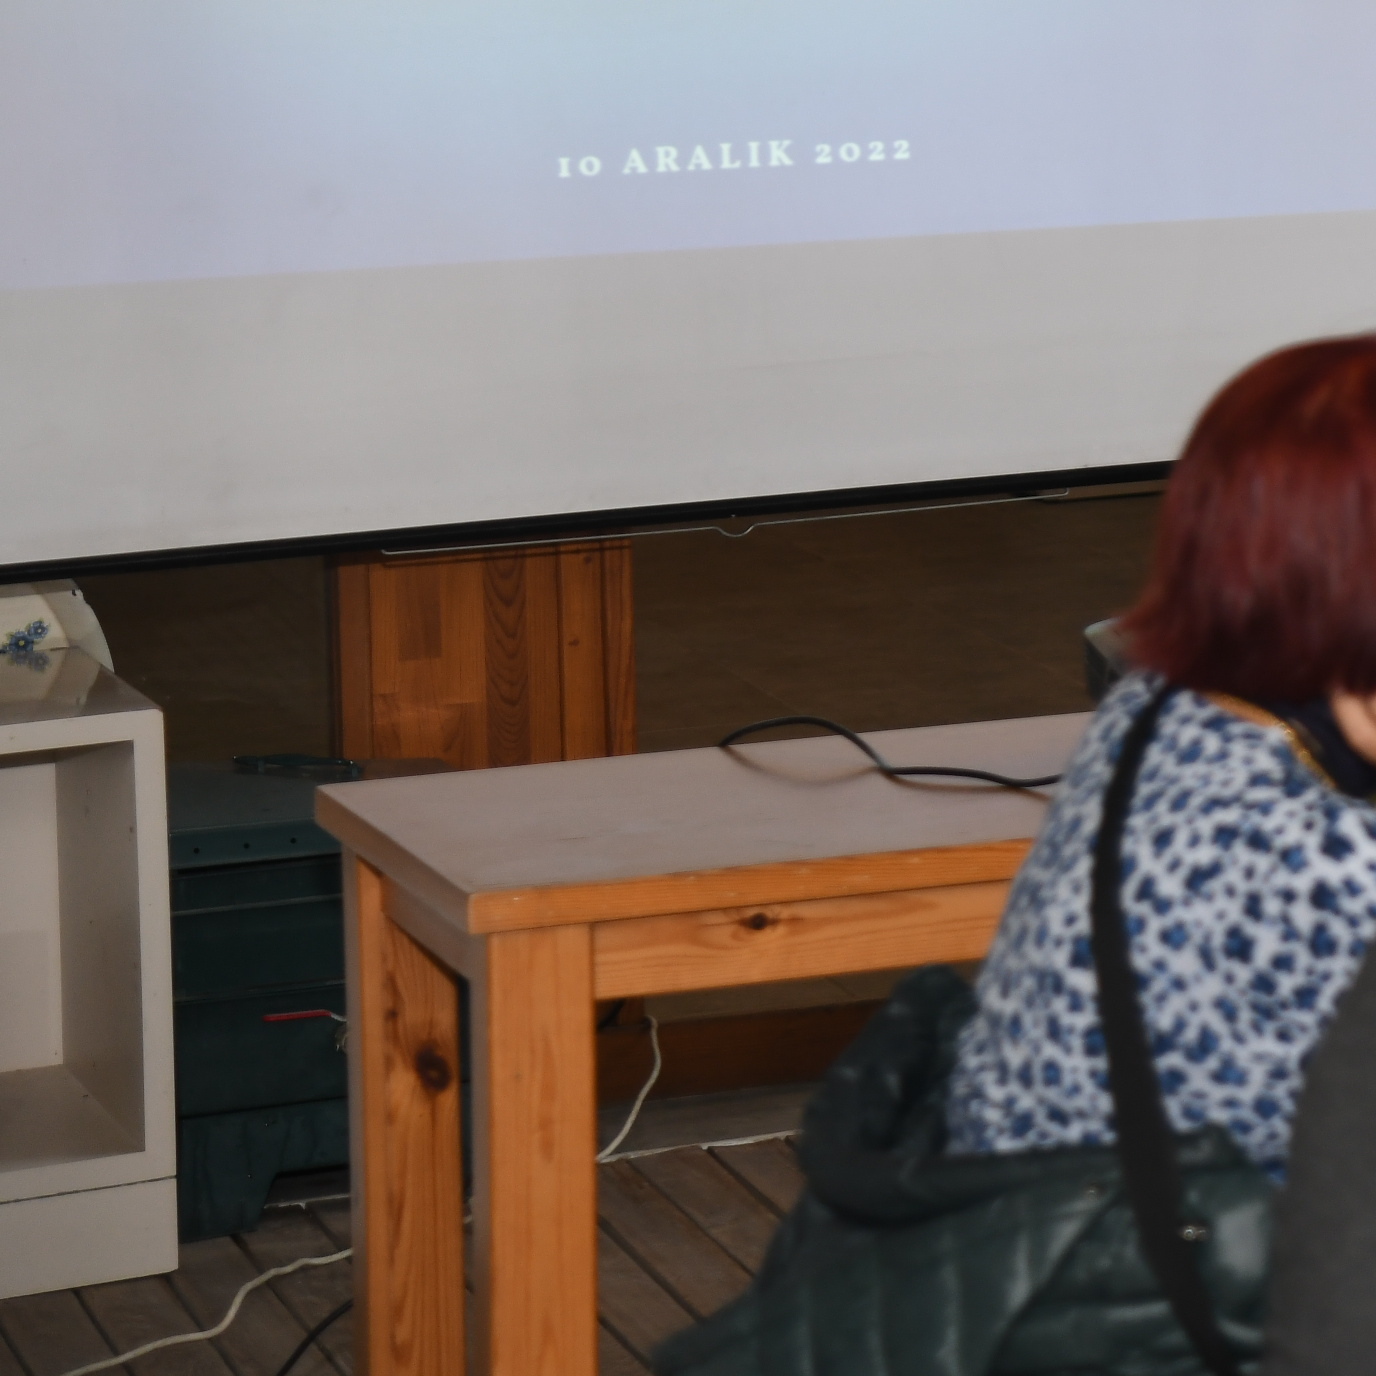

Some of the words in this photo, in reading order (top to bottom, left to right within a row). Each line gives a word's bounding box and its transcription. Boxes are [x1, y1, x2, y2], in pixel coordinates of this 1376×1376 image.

[559, 156, 602, 178] 10
[622, 140, 794, 174] ARALIK
[814, 139, 911, 165] 2022
